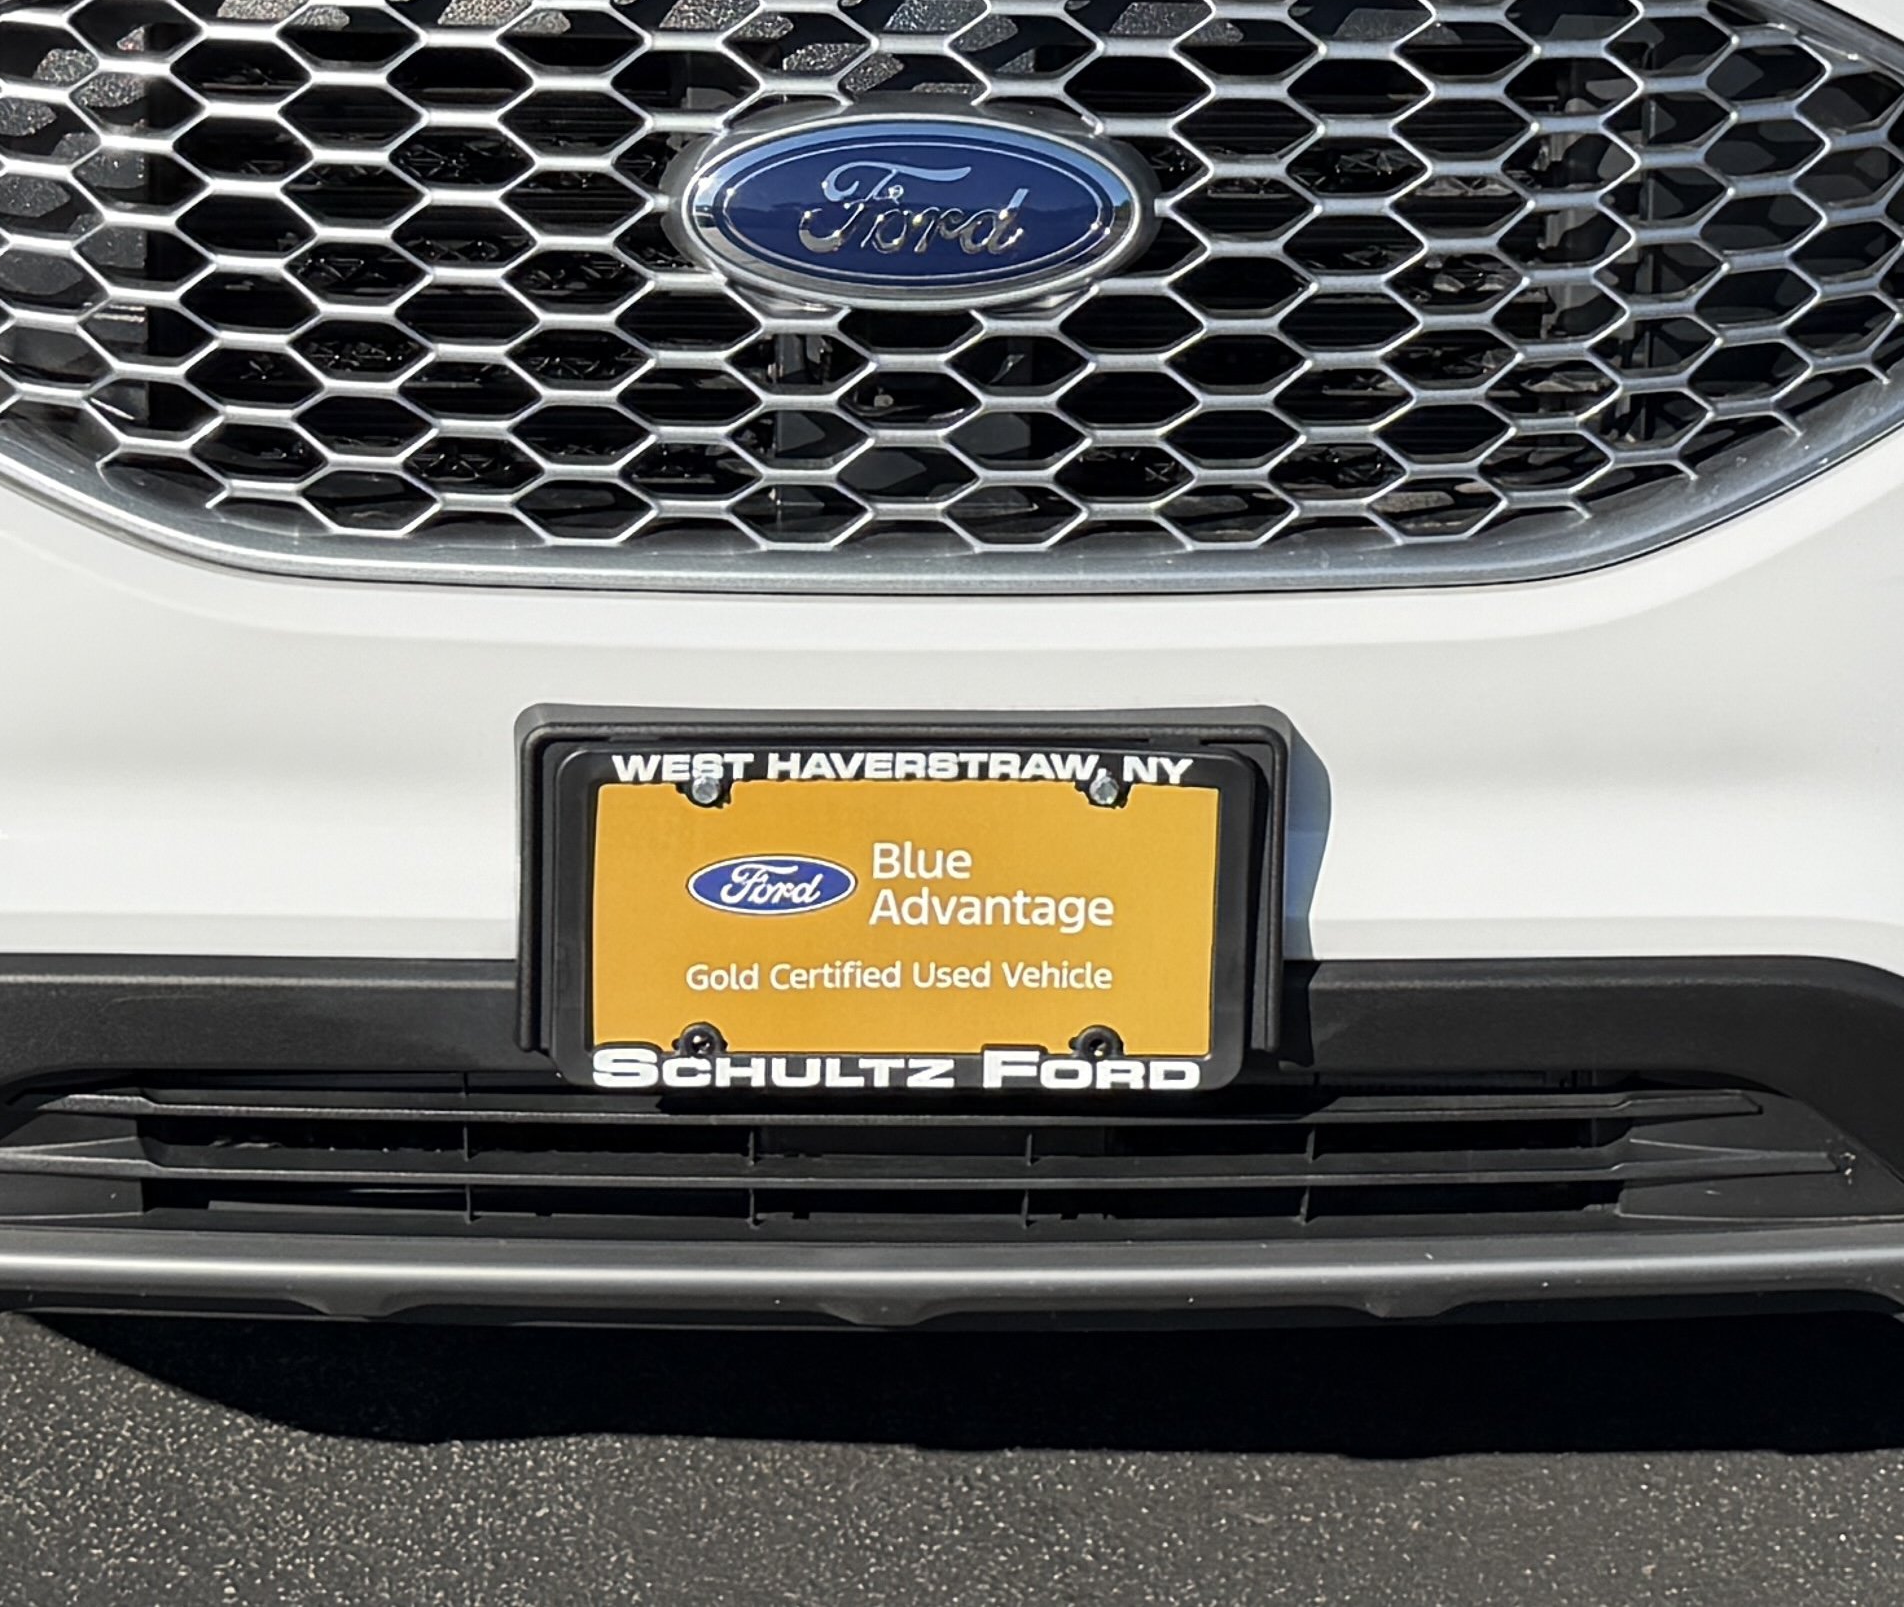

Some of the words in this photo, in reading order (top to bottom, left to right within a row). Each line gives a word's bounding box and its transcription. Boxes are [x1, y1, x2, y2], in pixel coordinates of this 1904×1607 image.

[798, 160, 1030, 255] Ford
[611, 752, 755, 782] WEST
[1123, 755, 1194, 785] NY
[872, 840, 973, 880] Blue
[720, 862, 824, 906] Ford
[868, 887, 1115, 934] Advantage
[685, 962, 760, 992] Gold
[769, 960, 902, 991] Certified
[913, 960, 992, 990] Used
[1001, 961, 1114, 991] Vehicle
